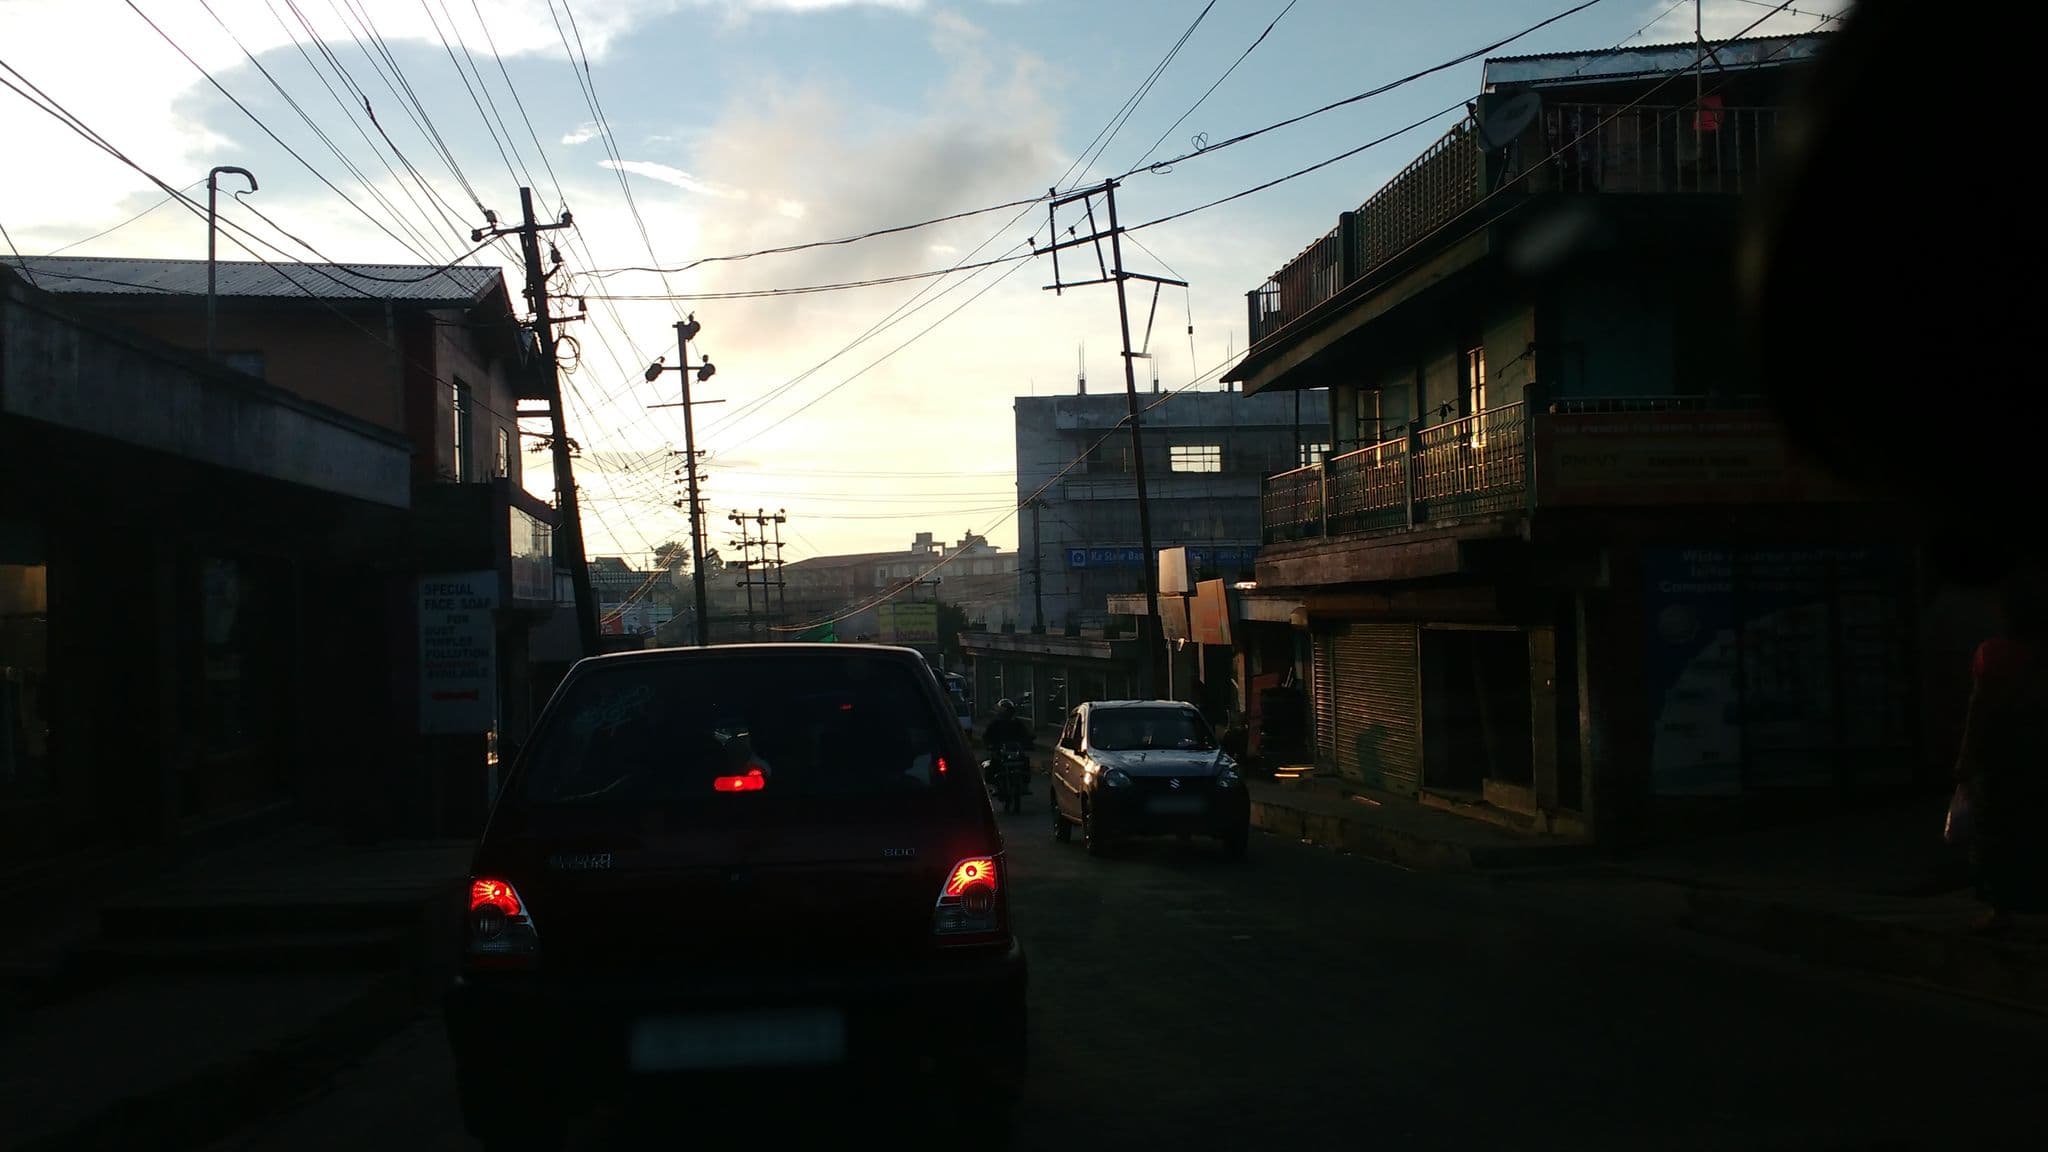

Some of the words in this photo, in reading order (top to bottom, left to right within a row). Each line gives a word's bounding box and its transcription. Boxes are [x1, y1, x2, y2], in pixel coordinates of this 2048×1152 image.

[424, 583, 473, 596] SPECIAL
[424, 598, 456, 611] FACE
[460, 597, 492, 610] SOAP
